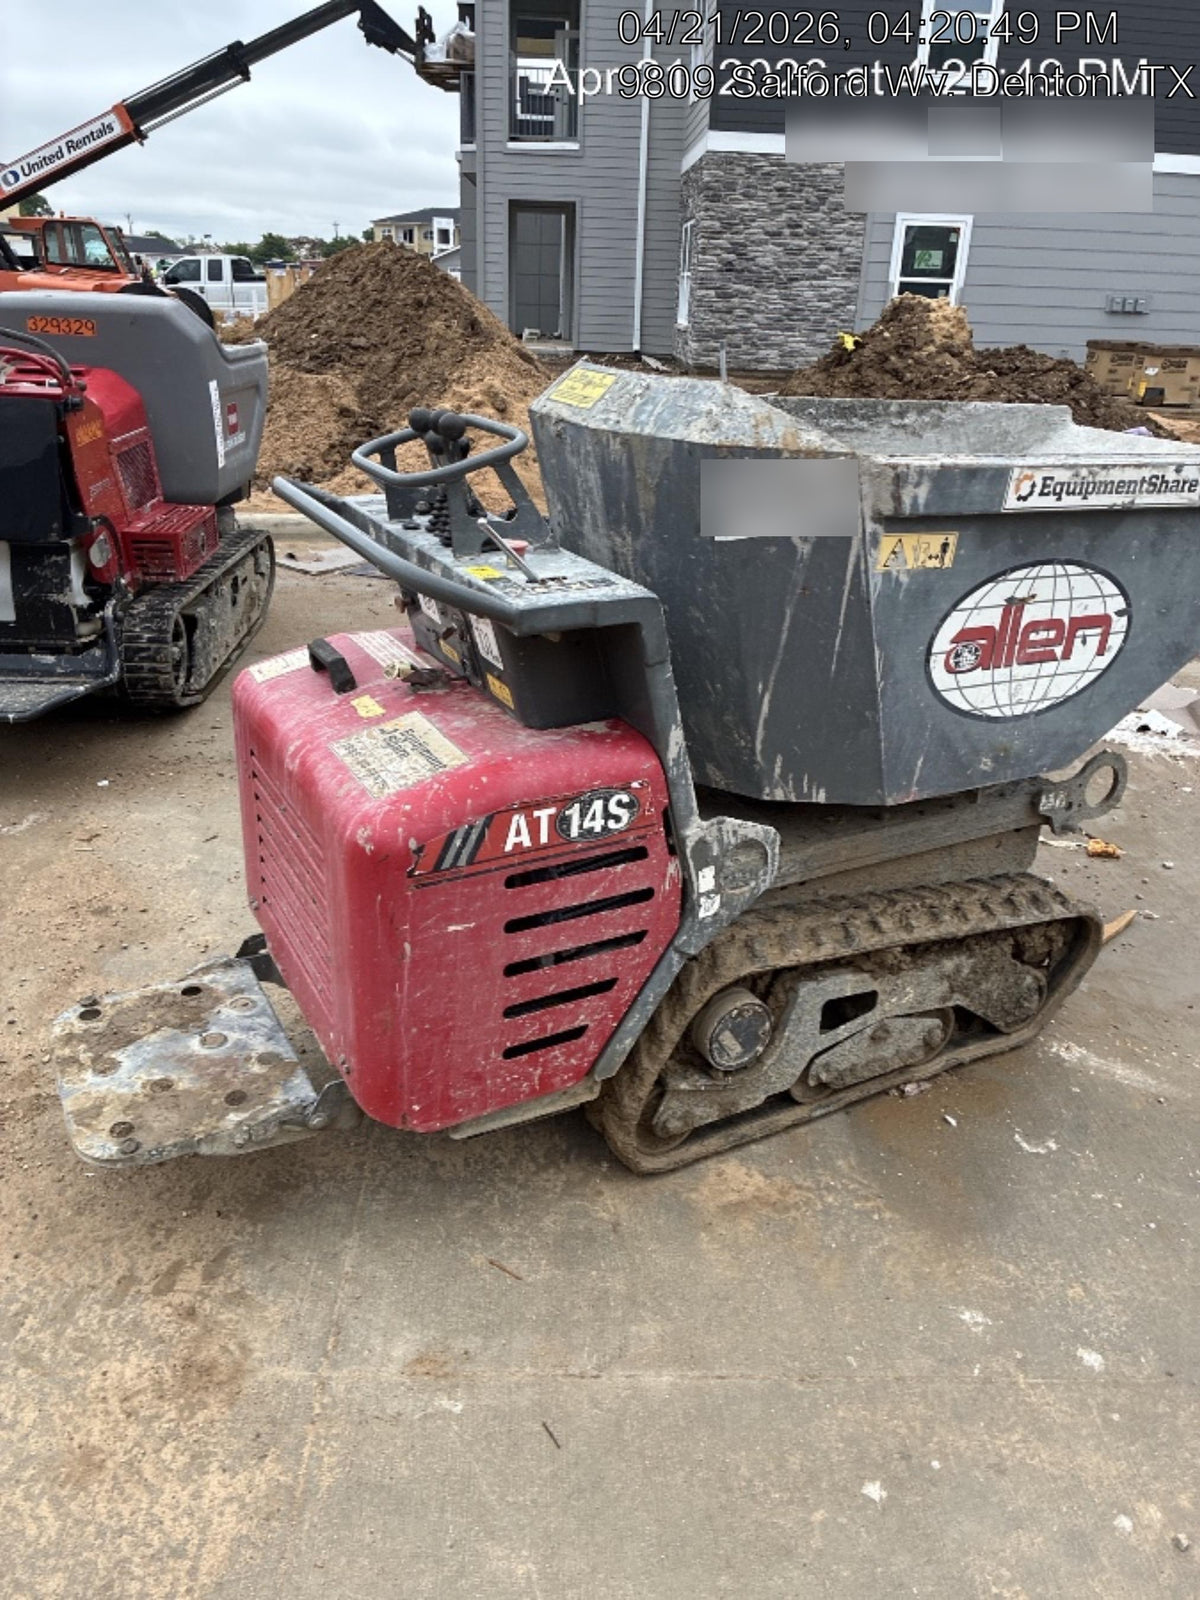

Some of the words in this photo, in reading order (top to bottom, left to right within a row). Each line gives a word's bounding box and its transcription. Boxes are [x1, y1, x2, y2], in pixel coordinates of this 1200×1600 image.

[20, 145, 65, 177] United
[65, 122, 115, 154] Rentals
[28, 315, 96, 334] 329329
[1038, 474, 1198, 502] EquipmentShare
[944, 601, 1113, 674] allen
[504, 807, 557, 852] AT
[565, 794, 630, 838] 14S
